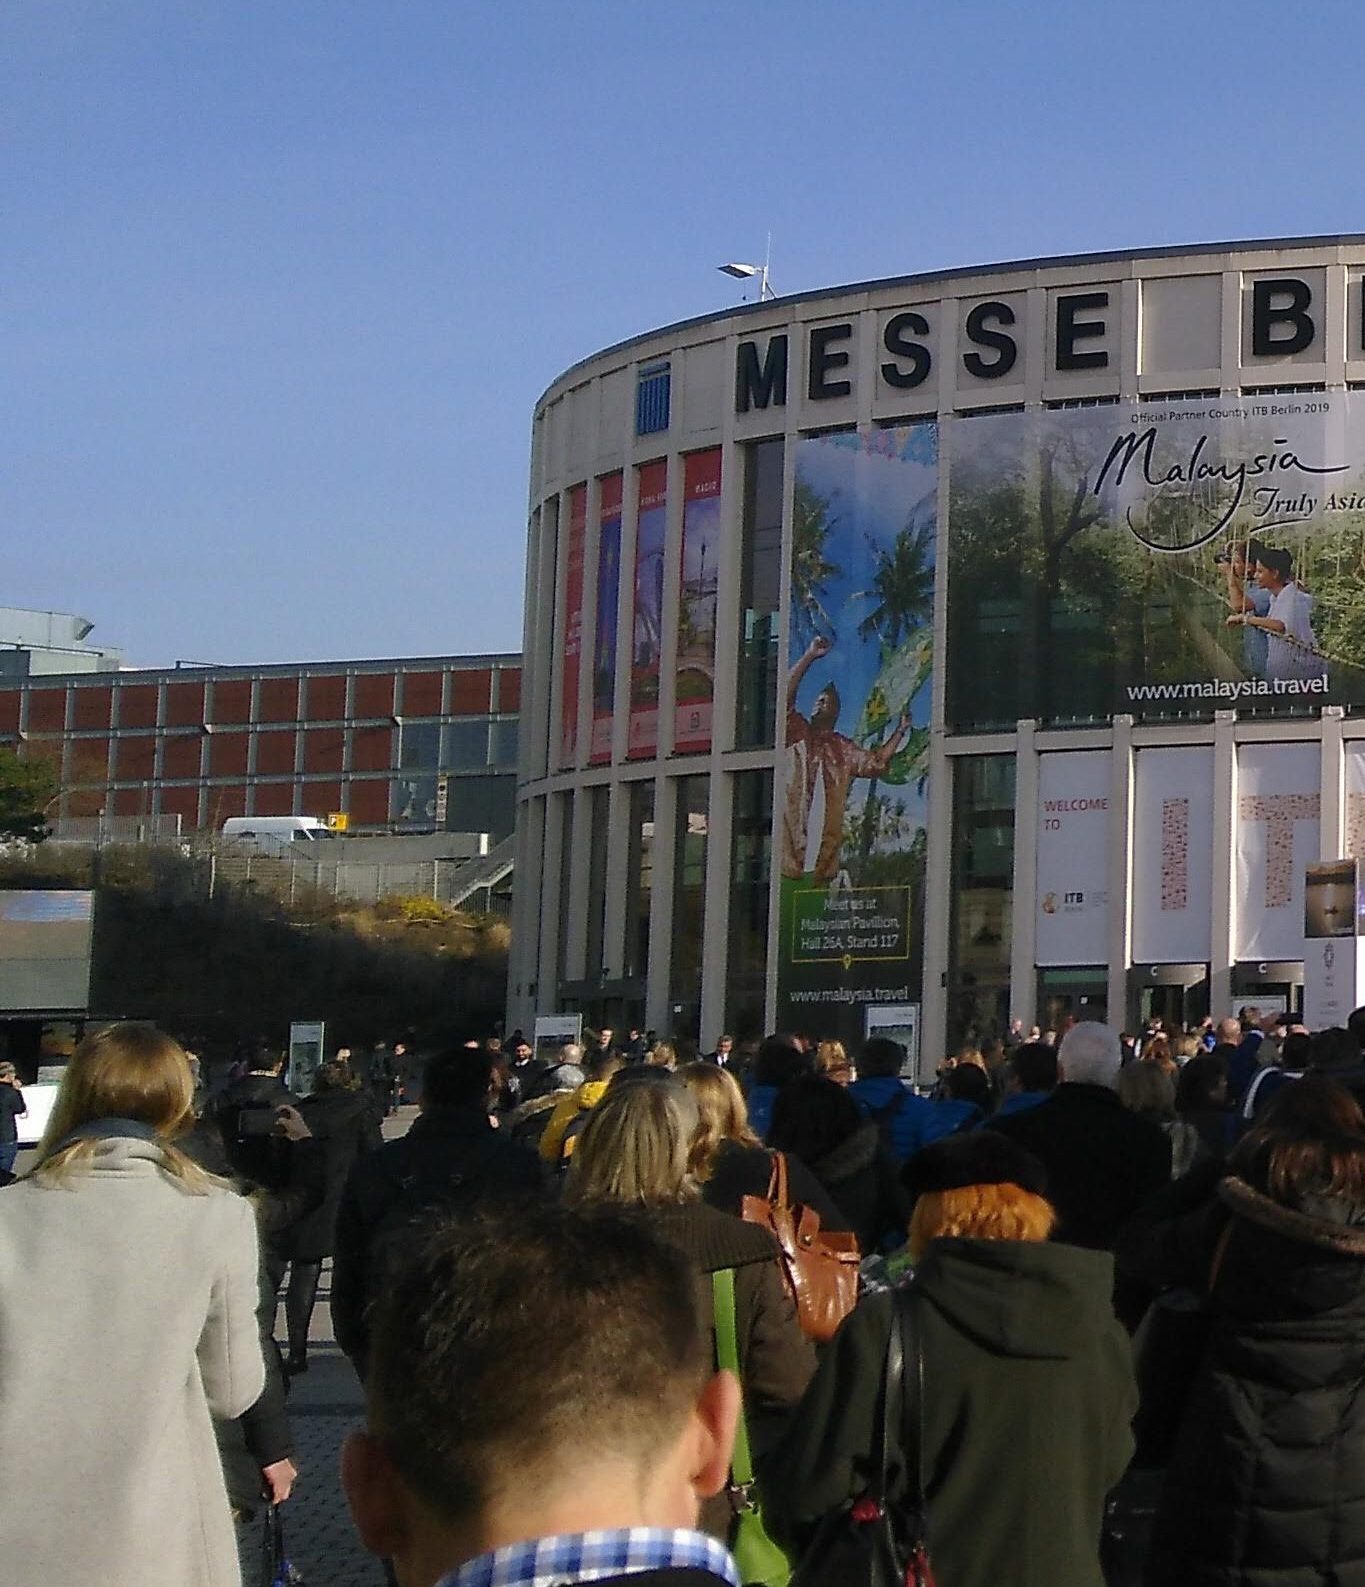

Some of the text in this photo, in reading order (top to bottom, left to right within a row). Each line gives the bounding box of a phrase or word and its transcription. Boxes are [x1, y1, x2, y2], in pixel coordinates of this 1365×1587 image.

[735, 292, 1108, 413] MESSE
[1131, 403, 1330, 423] Official Partner Country ITB Berlin 2019
[1094, 427, 1350, 551] Malaysia
[1253, 487, 1317, 517] Truly
[1127, 674, 1329, 700] www.malaysia.travel
[1044, 799, 1108, 812] WELCOME
[1044, 819, 1060, 831] TO
[823, 899, 848, 910] Meet
[1064, 892, 1084, 903] ITB
[800, 918, 850, 933] Malaysian
[801, 937, 821, 950] Hall
[847, 935, 878, 948] Stand
[880, 934, 899, 948] 117
[1151, 965, 1159, 977] C
[1259, 963, 1268, 974] C
[790, 986, 908, 1004] www.malaysia.travel
